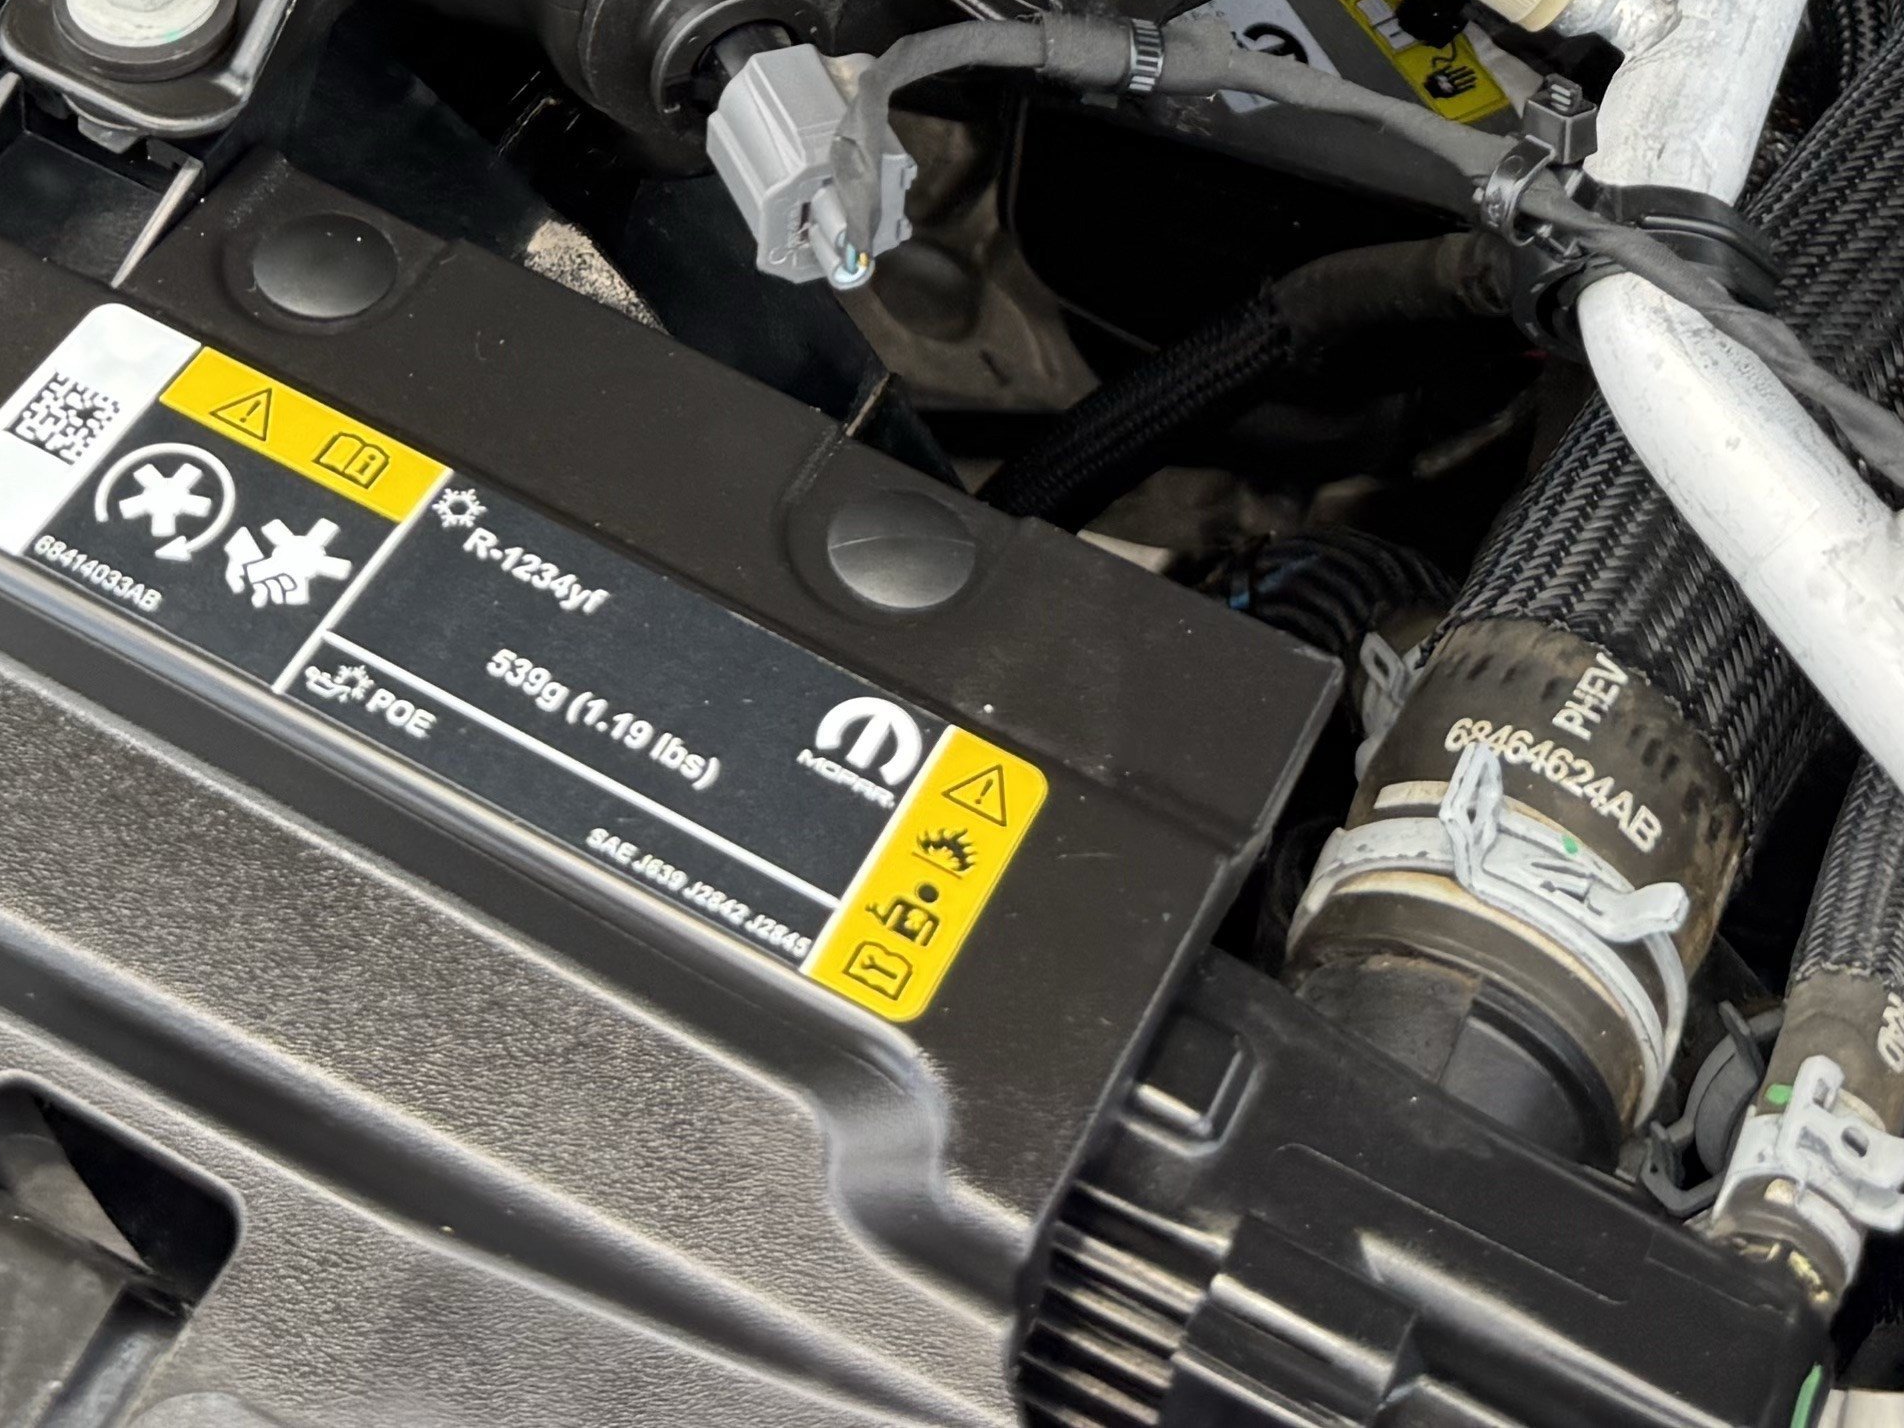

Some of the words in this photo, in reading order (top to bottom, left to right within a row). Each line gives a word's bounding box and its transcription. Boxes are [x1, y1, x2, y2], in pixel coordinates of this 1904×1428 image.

[33, 534, 164, 613] 68414033AB
[463, 526, 611, 615] R-1234yf
[365, 687, 439, 740] POE
[485, 647, 571, 713] 539g
[565, 691, 655, 751] (1.19
[648, 732, 722, 791] lbs)
[1552, 651, 1631, 741] PHEV
[1443, 716, 1664, 855] 68464624AB
[585, 827, 640, 866] SAE
[631, 853, 690, 892] J639
[681, 880, 753, 926] J2842
